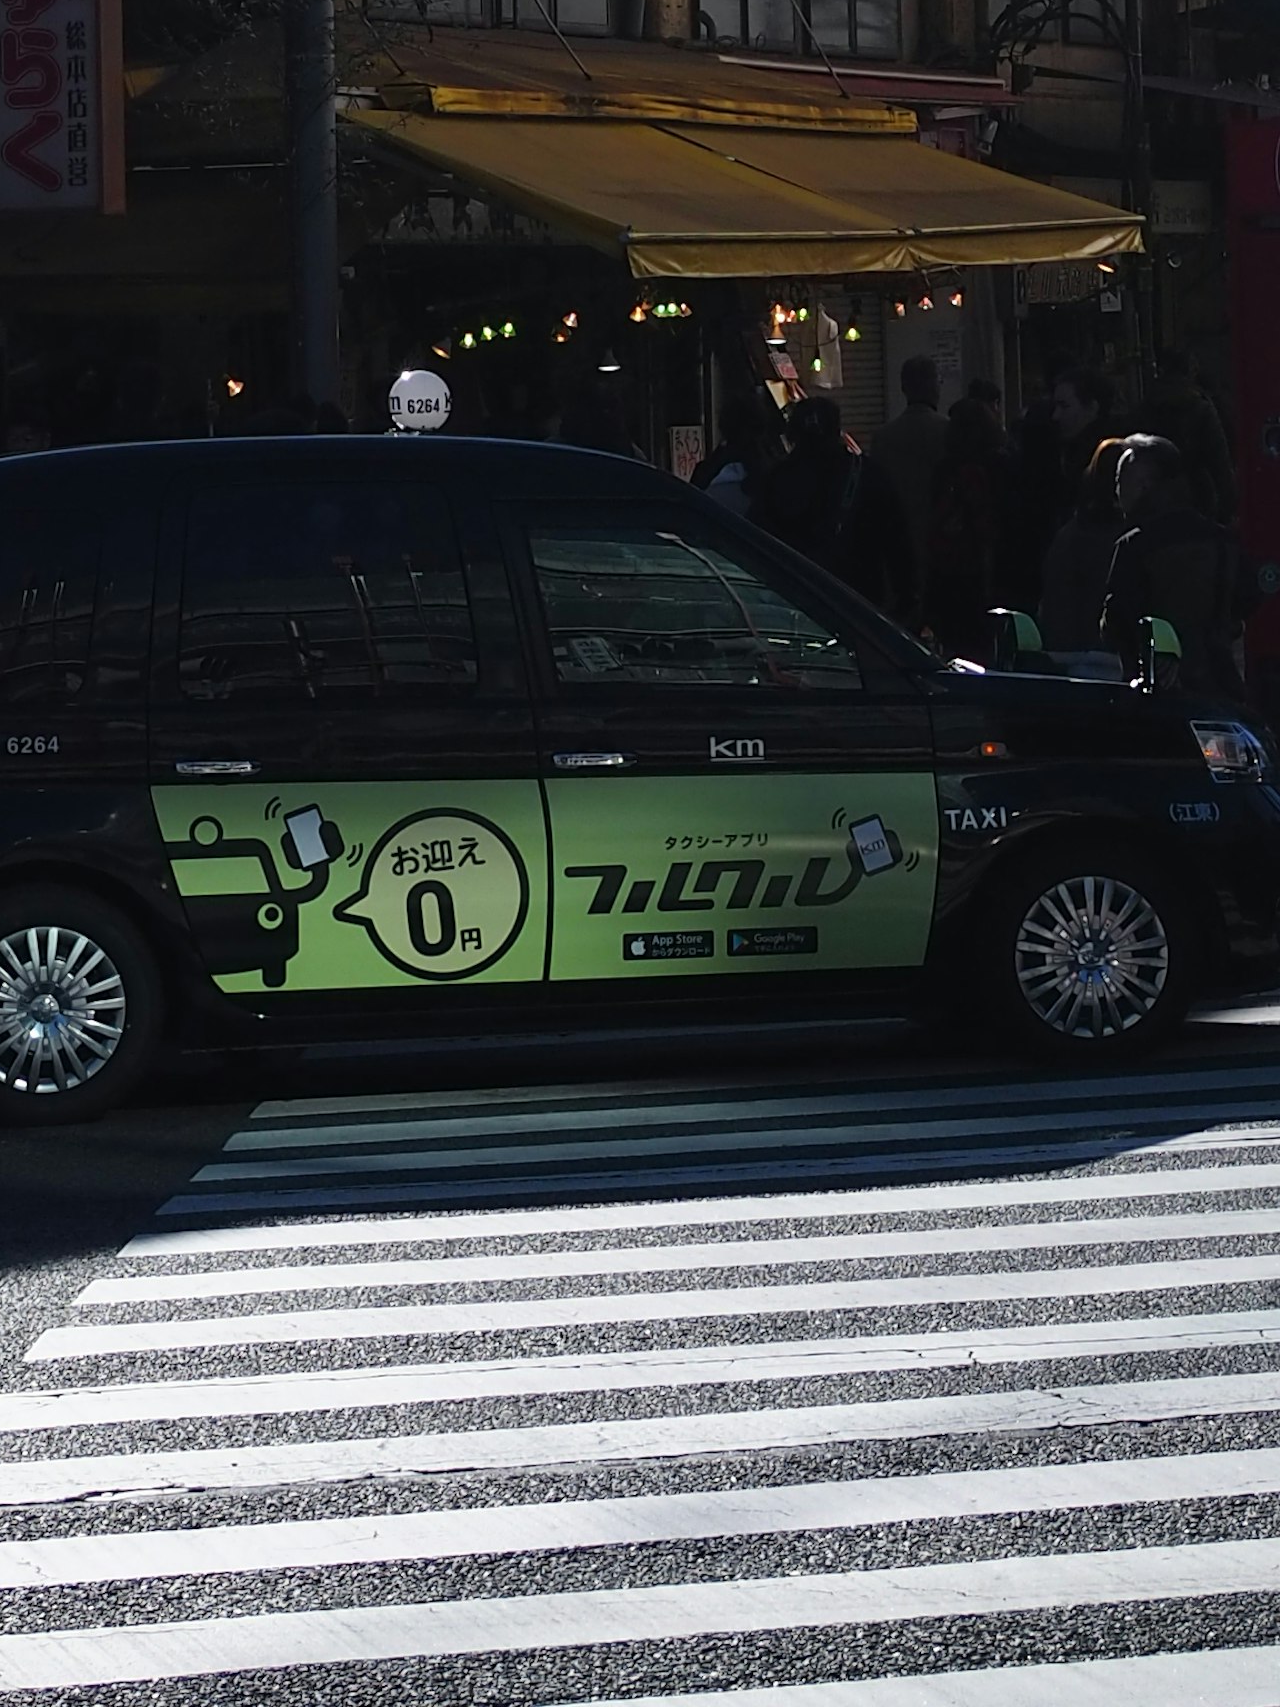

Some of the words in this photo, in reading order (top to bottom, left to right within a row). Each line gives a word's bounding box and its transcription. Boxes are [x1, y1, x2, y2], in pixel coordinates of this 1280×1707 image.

[65, 19, 89, 189] 総本店直営
[406, 397, 440, 415] 6264
[6, 735, 60, 755] 6264
[710, 735, 766, 761] km
[944, 808, 1008, 831] TAXI
[664, 832, 769, 851] タクシーアプリ
[390, 836, 487, 877] お迎え
[651, 933, 673, 947] App
[675, 932, 704, 945] Store
[753, 932, 786, 945] Google
[787, 930, 806, 944] Play
